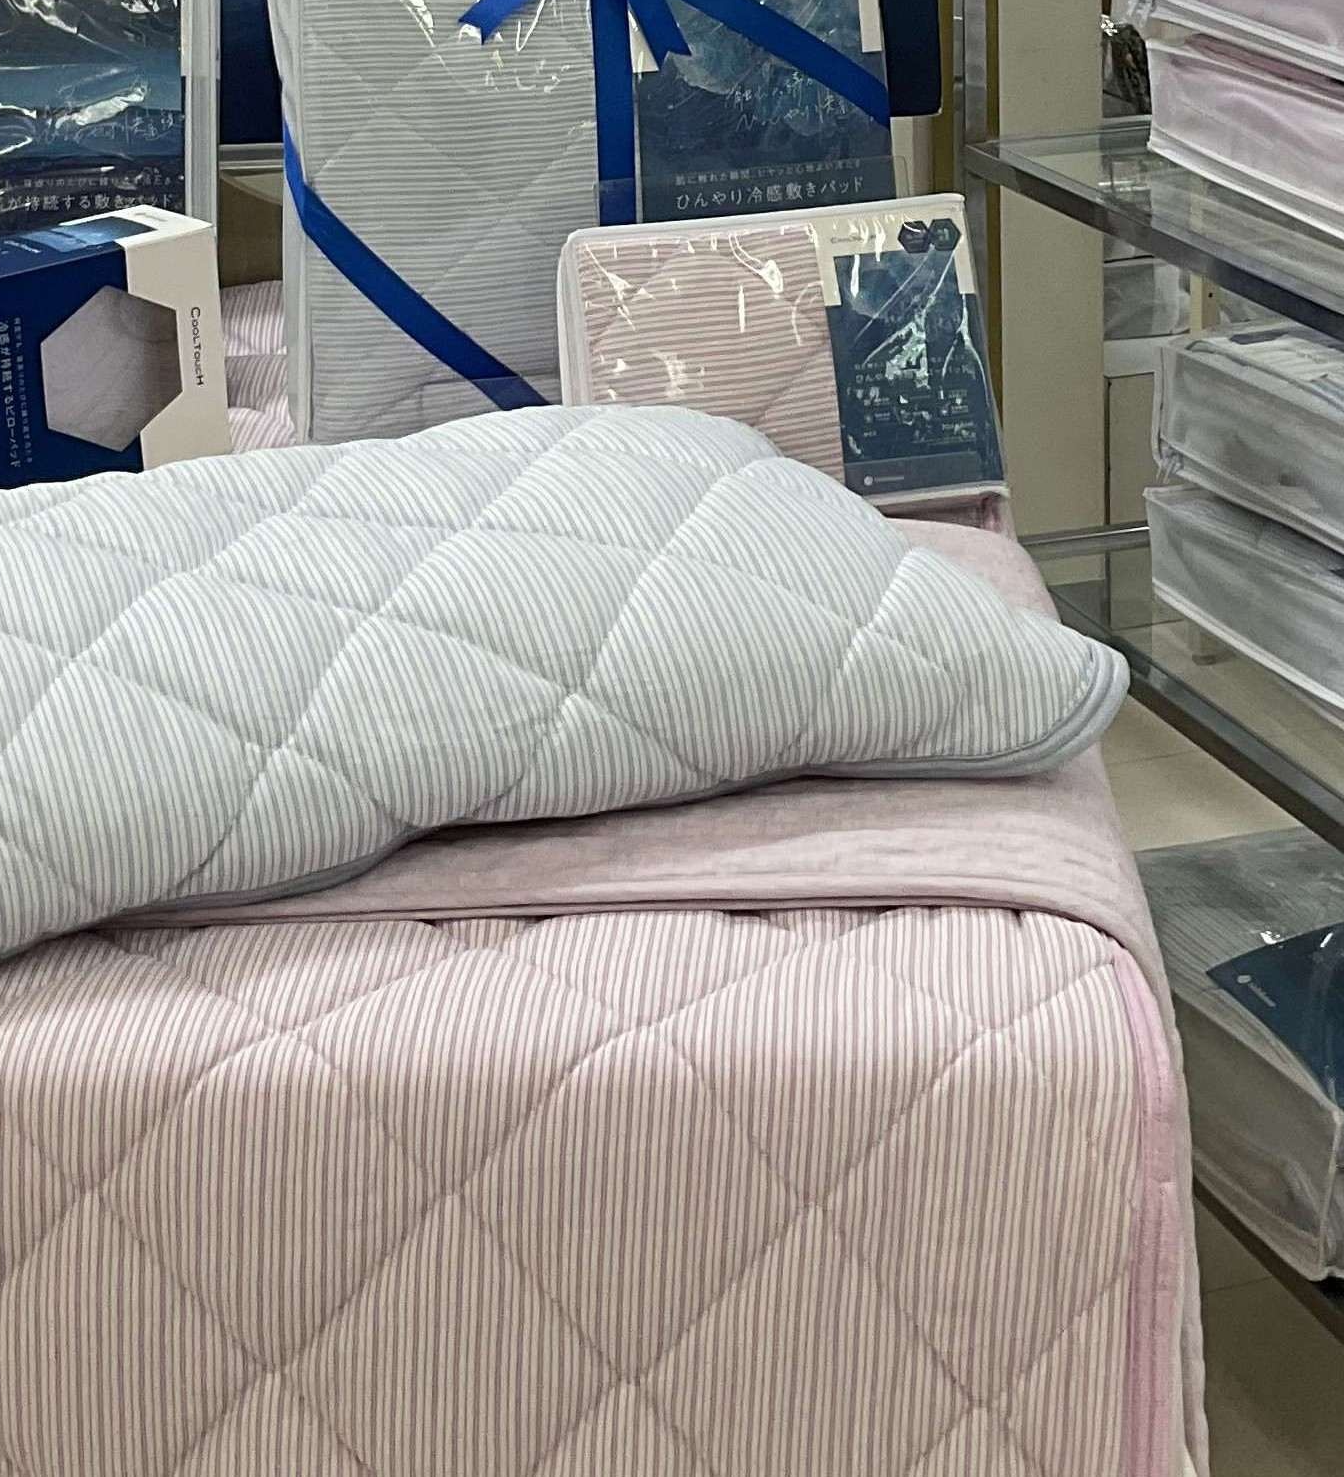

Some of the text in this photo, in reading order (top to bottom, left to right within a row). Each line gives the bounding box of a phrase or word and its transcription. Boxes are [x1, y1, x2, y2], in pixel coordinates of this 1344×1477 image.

[676, 175, 864, 211] ひんやり冷感敷きパッド
